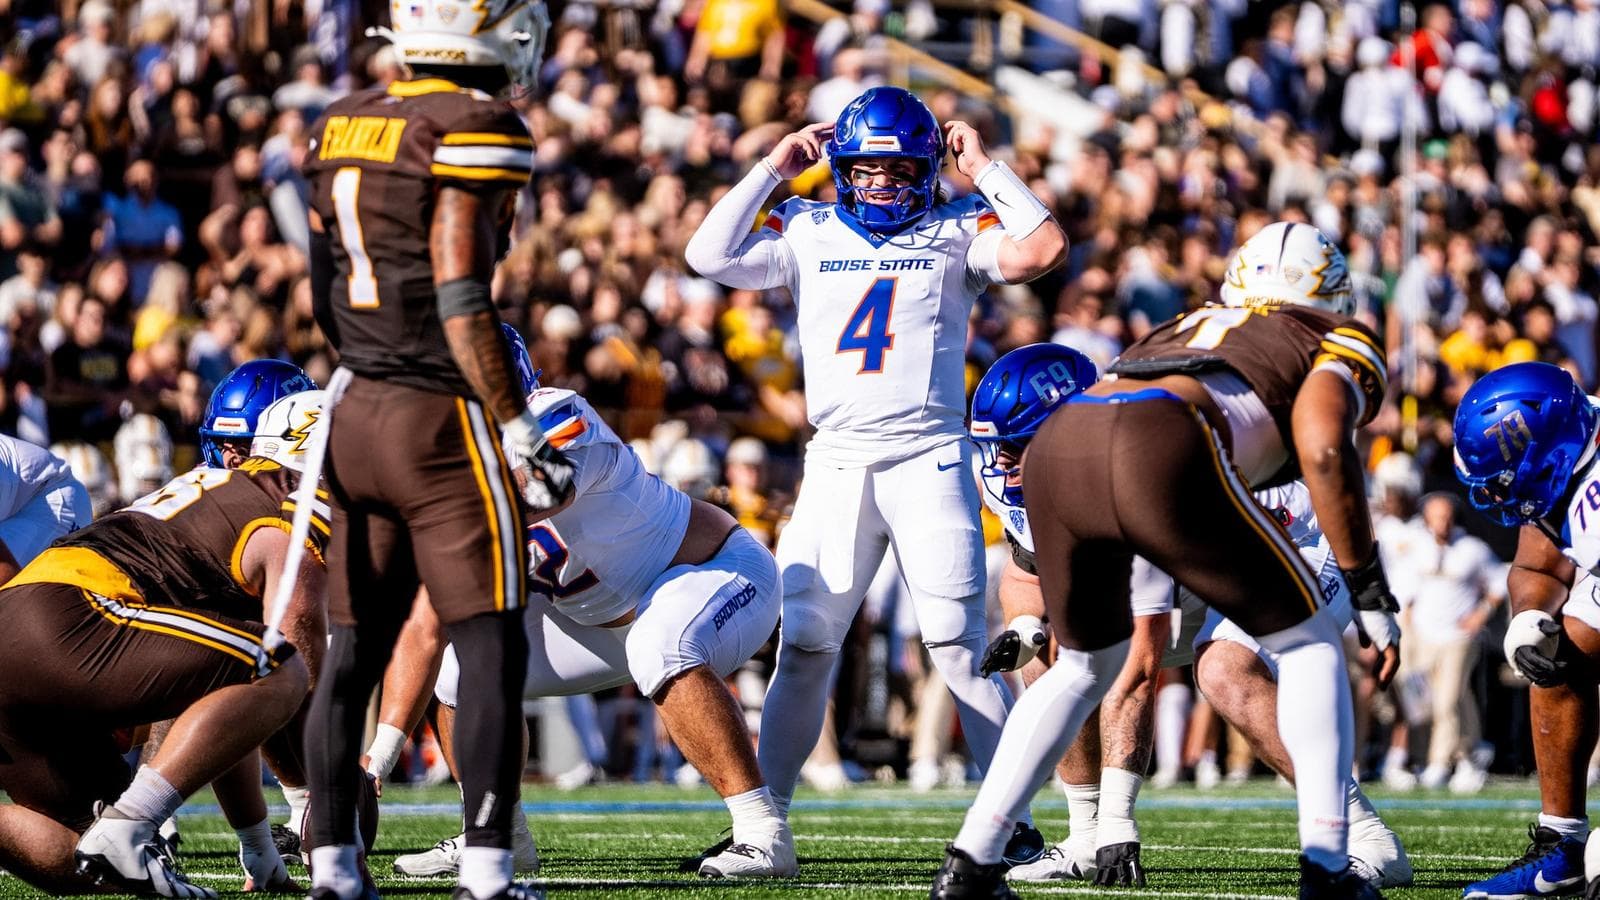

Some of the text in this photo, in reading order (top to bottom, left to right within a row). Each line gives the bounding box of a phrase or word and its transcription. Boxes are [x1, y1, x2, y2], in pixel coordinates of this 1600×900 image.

[331, 166, 380, 308] 1
[819, 258, 936, 272] BOISE STATE
[834, 276, 899, 376] 4
[1029, 361, 1077, 408] 69
[1574, 480, 1600, 533] 78
[712, 582, 757, 632] BRONCOS
